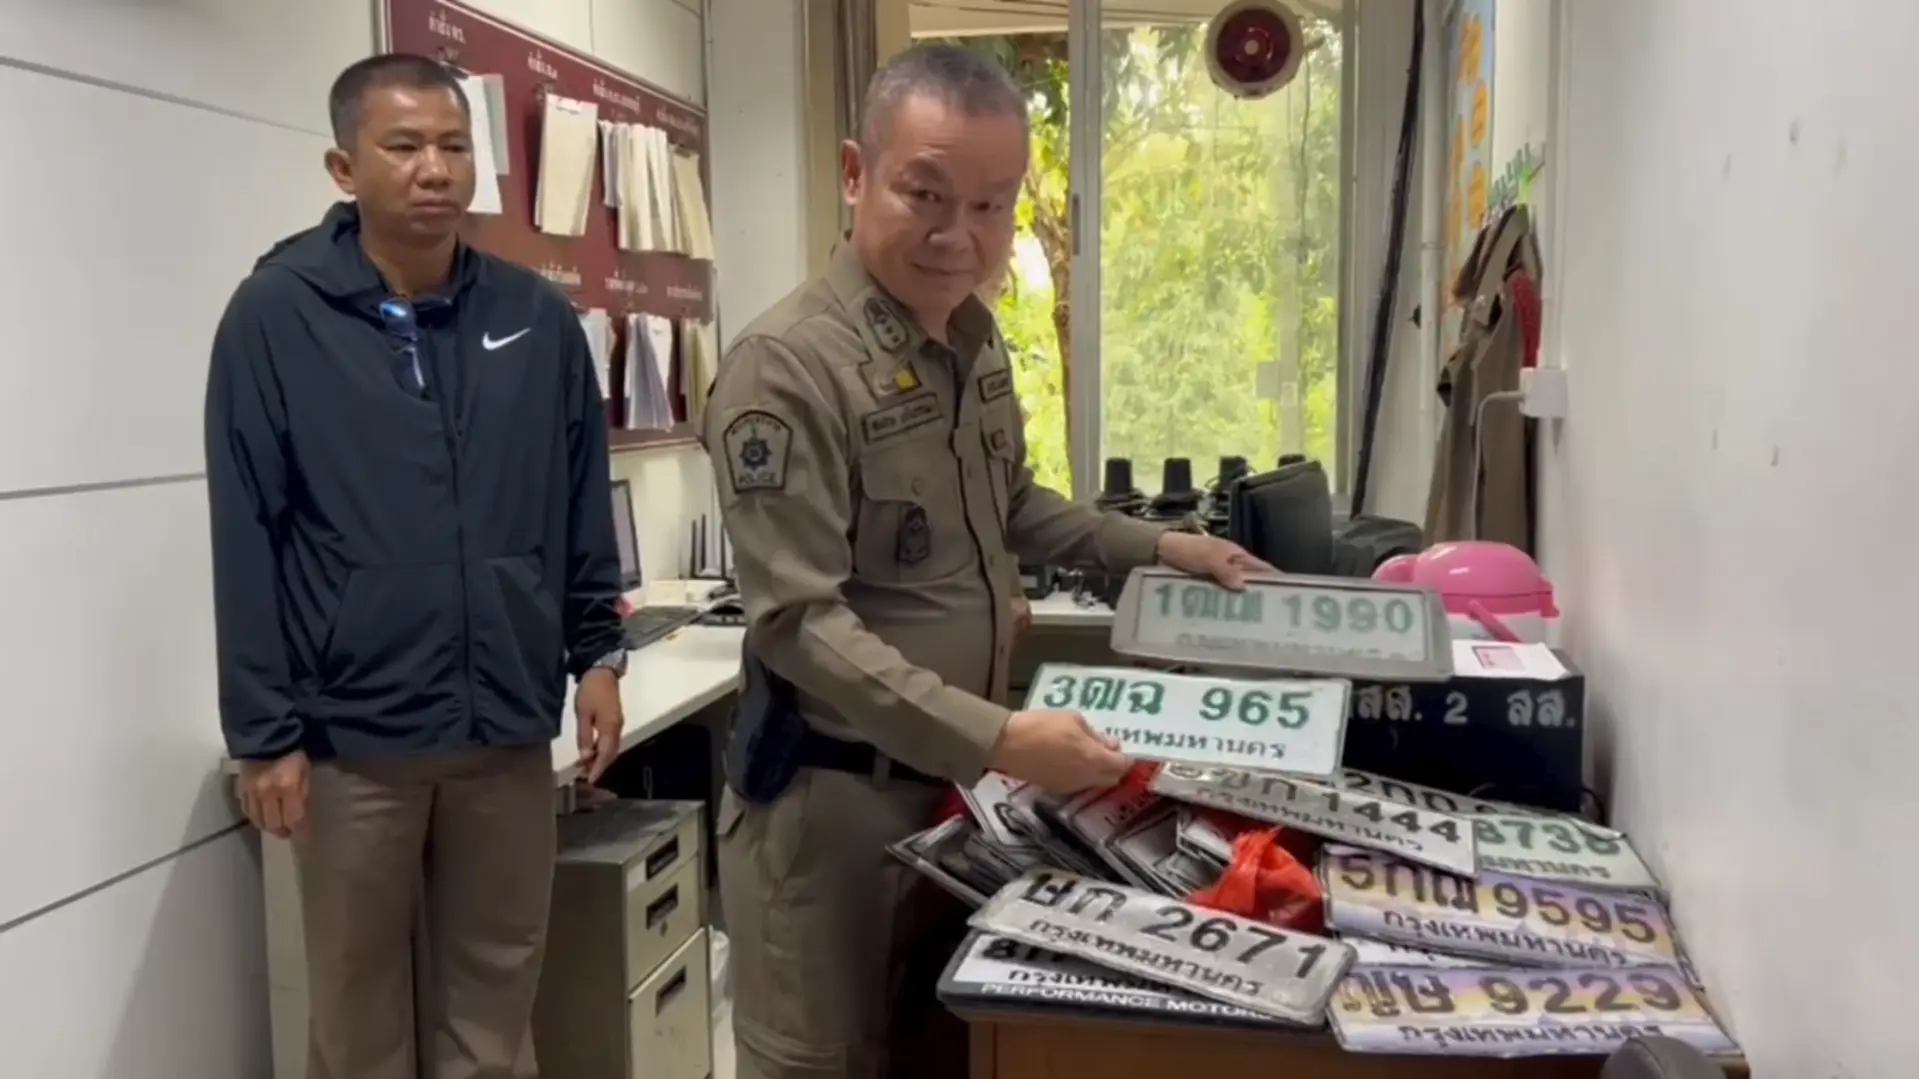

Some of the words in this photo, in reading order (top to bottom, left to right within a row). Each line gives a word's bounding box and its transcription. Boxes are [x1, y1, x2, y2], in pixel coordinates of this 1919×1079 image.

[1282, 593, 1414, 634] 1990
[1199, 687, 1312, 730] 965
[1444, 692, 1468, 724] 2
[1321, 790, 1461, 844] 1444
[1493, 881, 1656, 944] 9595
[1029, 918, 1264, 997] กรุงเทพมหานคร
[1141, 905, 1327, 979] 2671
[981, 983, 1160, 1008] PERFORMANCE
[1166, 1000, 1272, 1019] MOTO
